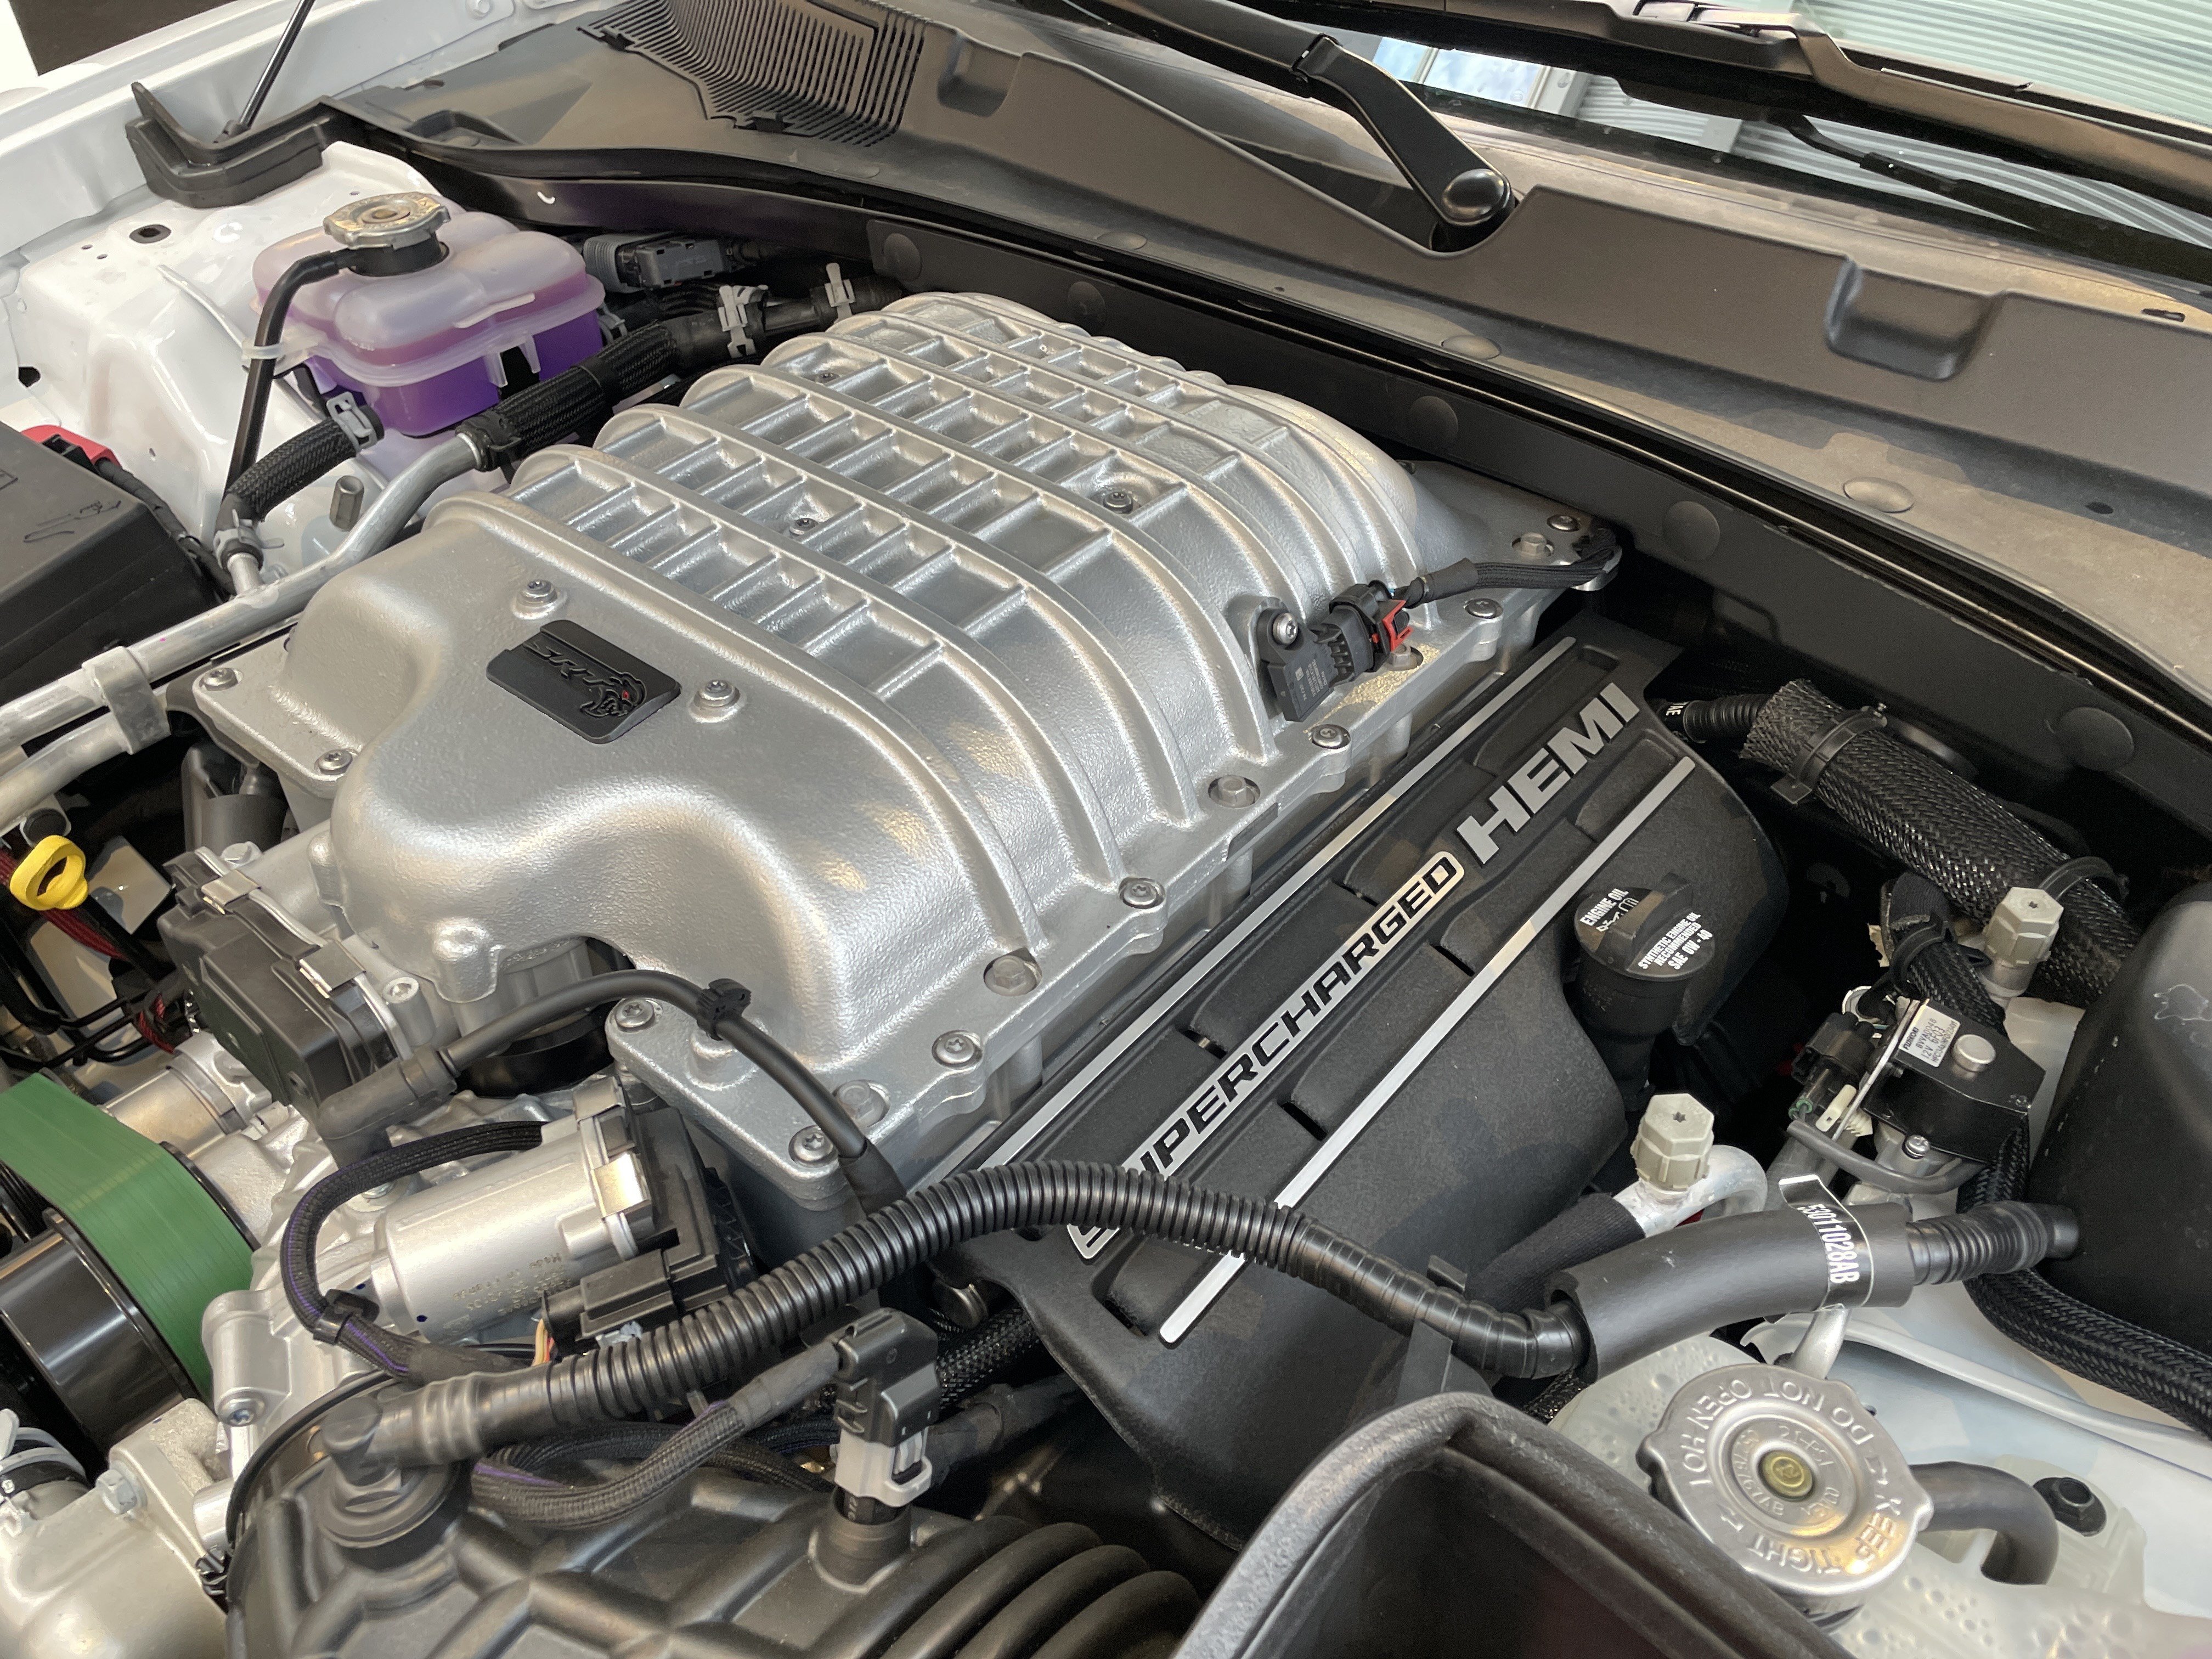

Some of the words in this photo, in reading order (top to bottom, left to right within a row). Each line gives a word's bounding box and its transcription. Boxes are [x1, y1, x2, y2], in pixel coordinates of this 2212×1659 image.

[1579, 898, 1617, 926] ENGINE
[1607, 888, 1629, 901] OIL
[1638, 936, 1672, 969] SYNTHETIC
[1666, 918, 1692, 939] ENGINE
[1686, 912, 1701, 922] OIL
[1653, 922, 1702, 966] RECOMMENDED
[1667, 952, 1689, 970] SAE
[1077, 857, 1457, 1248] PERCHARGED
[1456, 682, 1640, 864] HEMI
[1686, 1379, 1752, 1430] OPEN
[1763, 1376, 1825, 1411] NOT
[1831, 1407, 1874, 1445] DO
[1680, 1434, 1712, 1488] HOT
[1854, 1493, 1902, 1560] KEEP
[1748, 1534, 1841, 1575] TIGHT
